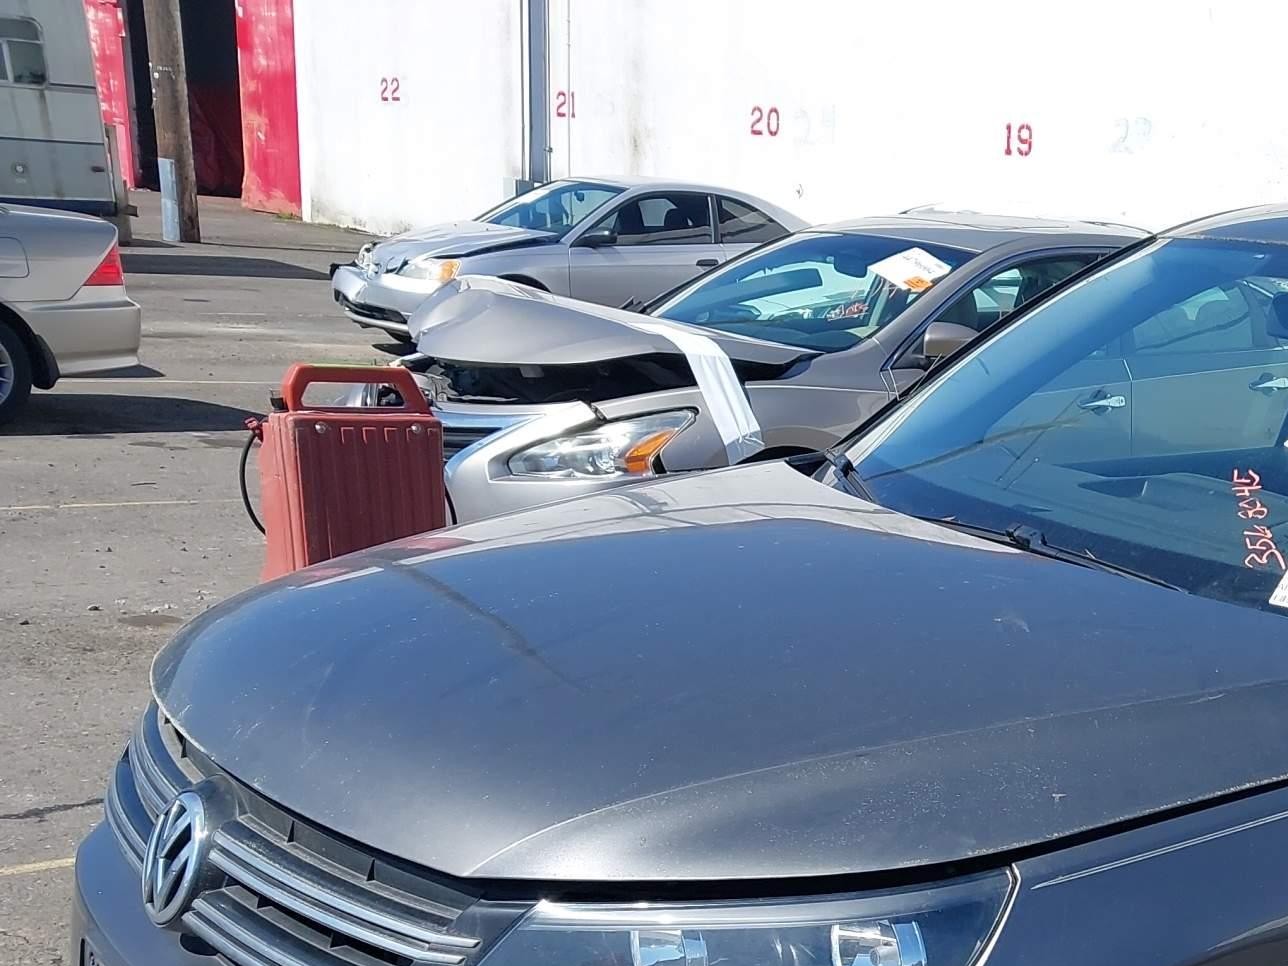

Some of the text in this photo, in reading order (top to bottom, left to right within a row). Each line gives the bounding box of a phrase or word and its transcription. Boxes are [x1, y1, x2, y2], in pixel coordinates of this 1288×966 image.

[380, 77, 401, 101] 22
[555, 91, 576, 118] 21
[750, 106, 780, 137] 20
[1004, 123, 1034, 156] 19
